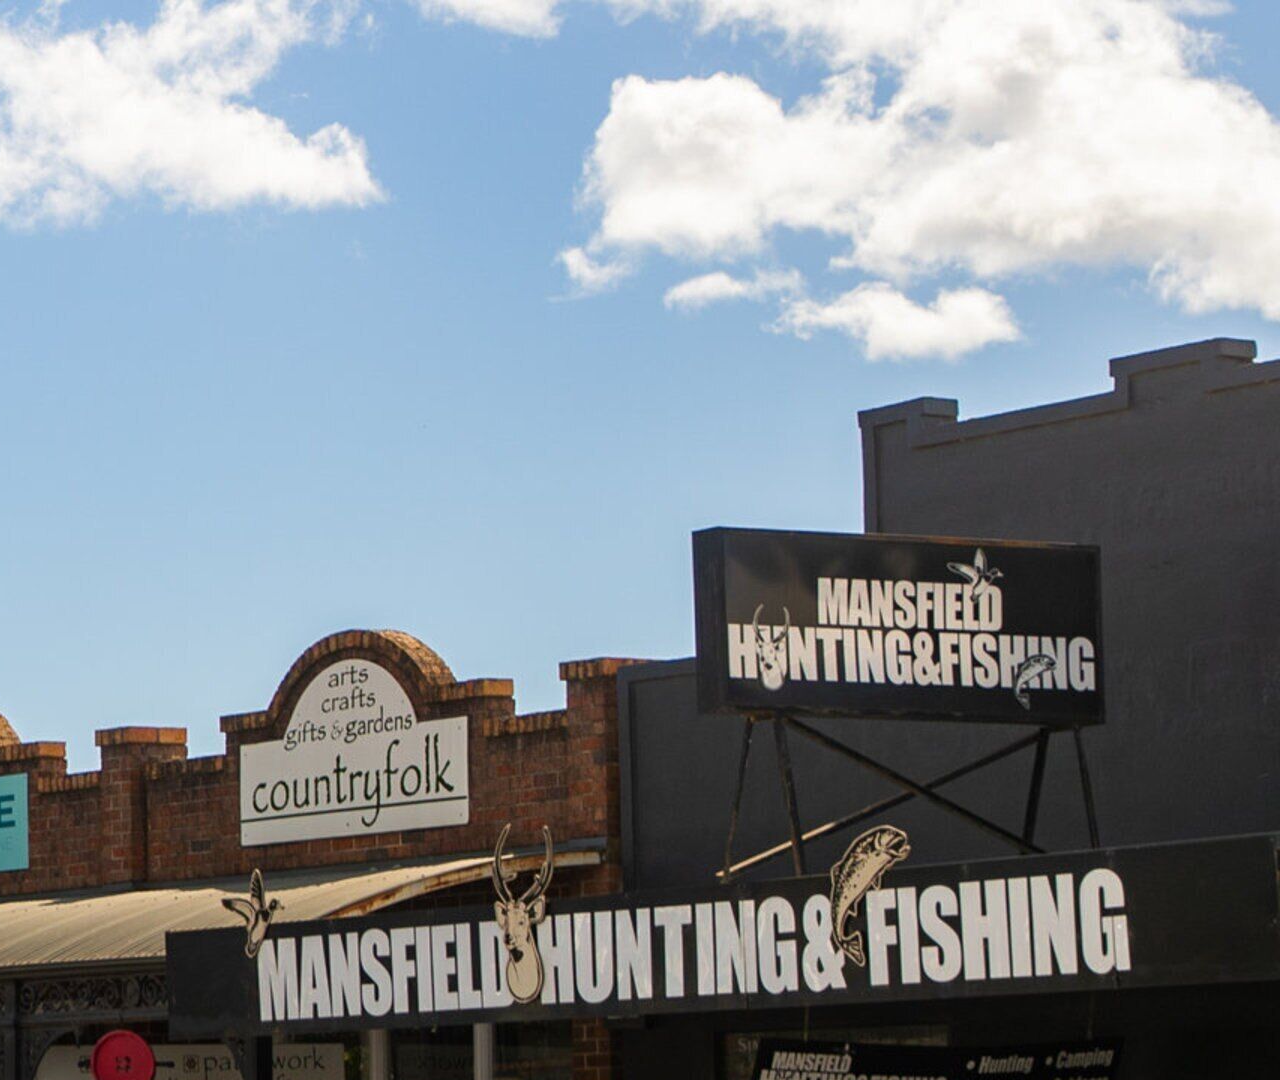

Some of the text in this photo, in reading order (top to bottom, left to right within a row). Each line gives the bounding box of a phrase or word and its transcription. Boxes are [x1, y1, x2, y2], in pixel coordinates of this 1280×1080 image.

[817, 576, 1003, 632] MANSFIELD
[328, 666, 369, 688] arts
[321, 686, 376, 714] crafts
[284, 720, 327, 751] gifts
[343, 706, 413, 744] gardens
[252, 732, 454, 828] countryfolk
[257, 918, 514, 1023] MANSFIELD
[867, 867, 1132, 987] FISHING
[771, 1050, 852, 1072] MANSFIELD
[979, 1047, 1115, 1075] Hunting Camping
